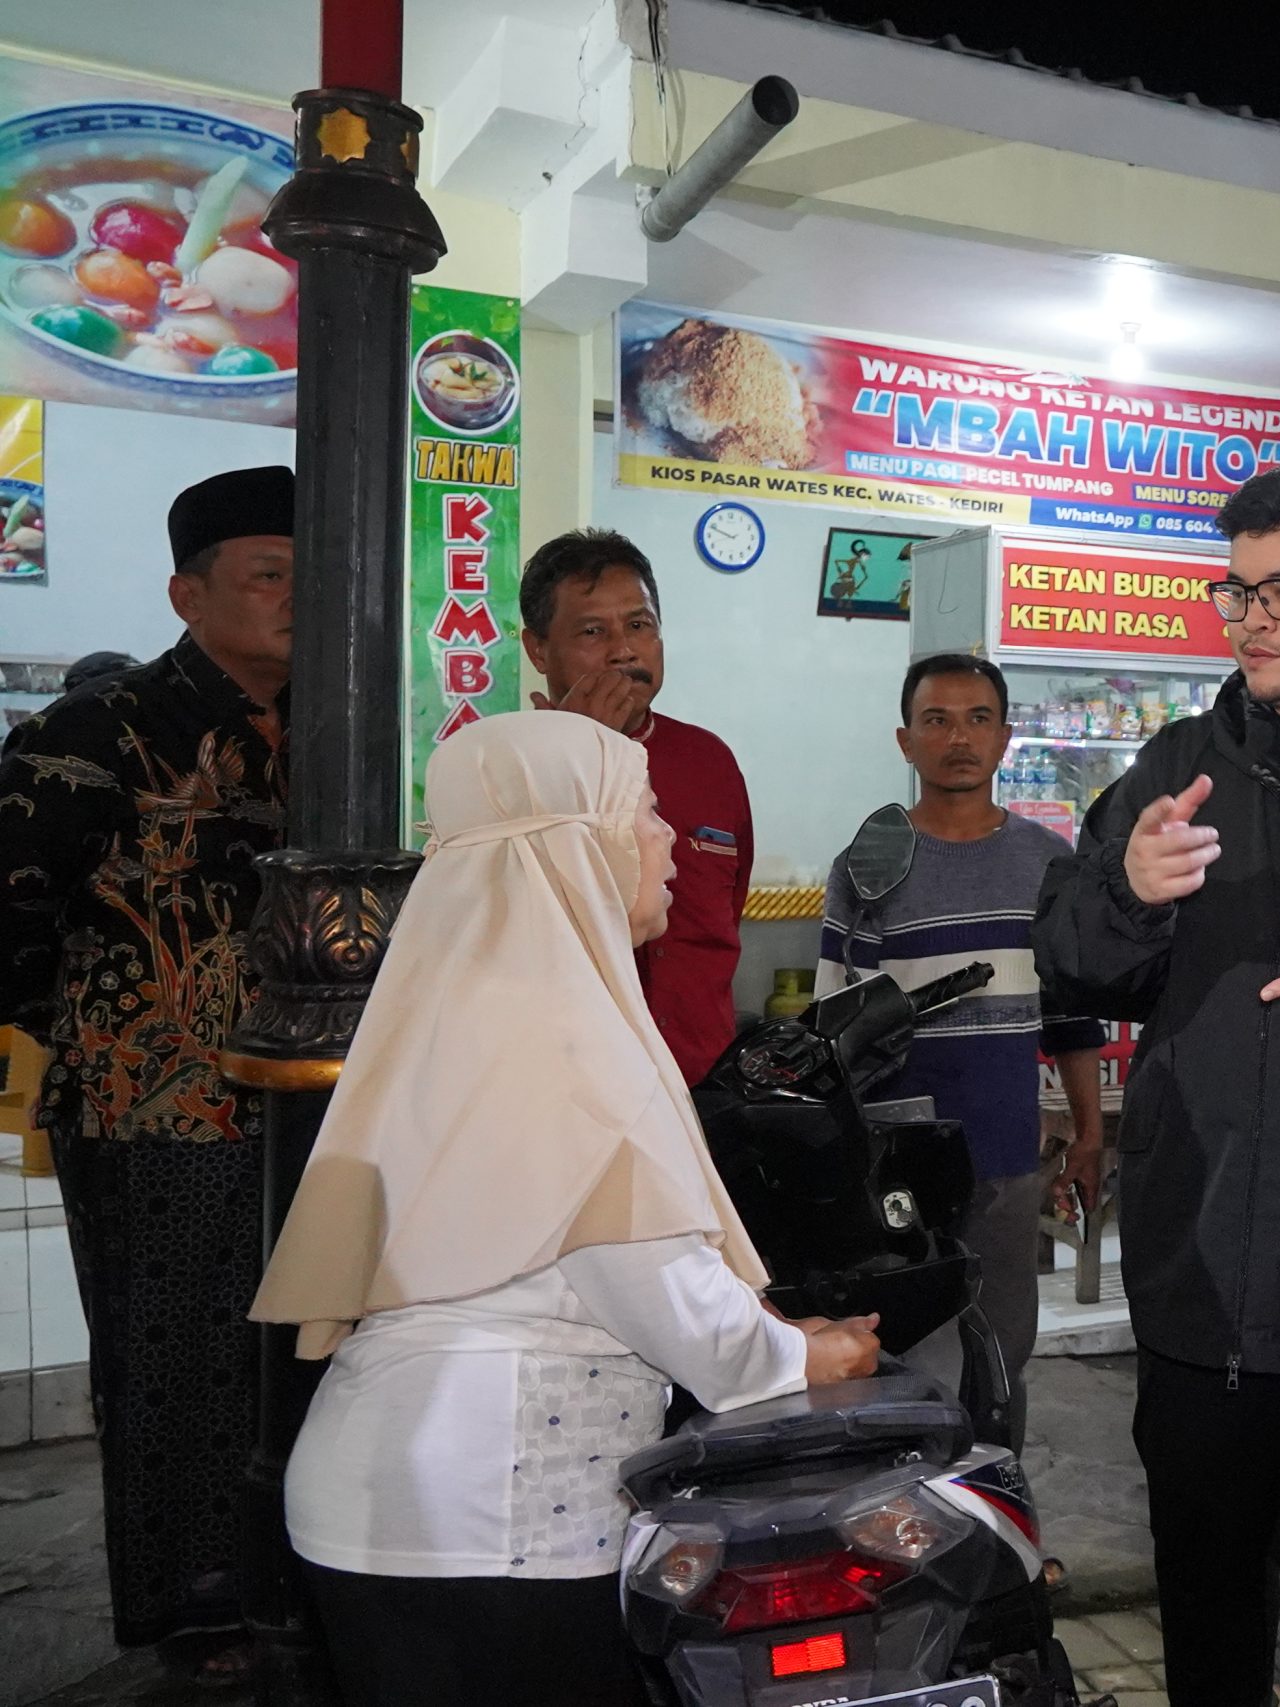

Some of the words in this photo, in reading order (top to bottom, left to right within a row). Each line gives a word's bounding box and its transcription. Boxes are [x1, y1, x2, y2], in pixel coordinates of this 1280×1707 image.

[859, 355, 1031, 401] WARUNG
[1039, 386, 1154, 417] KETAN
[415, 440, 515, 486] TAKWA
[851, 454, 908, 475] MENU
[911, 461, 960, 481] PAGI
[966, 467, 1020, 487] PECEL
[1022, 473, 1114, 496] TUMPANG
[651, 466, 696, 482] KIOS
[701, 470, 760, 489] PASAR
[766, 478, 828, 495] WATES
[833, 485, 872, 500] KEC.
[878, 489, 935, 506] WATES
[949, 497, 1003, 513] KEDIRI
[1135, 485, 1186, 503] MENU
[1055, 507, 1134, 529] WhatsApp
[1156, 517, 1183, 531] 085
[1185, 520, 1214, 533] 604
[1009, 563, 1106, 595] KETAN
[1009, 603, 1107, 635] KETAN
[1114, 611, 1189, 639] RASA
